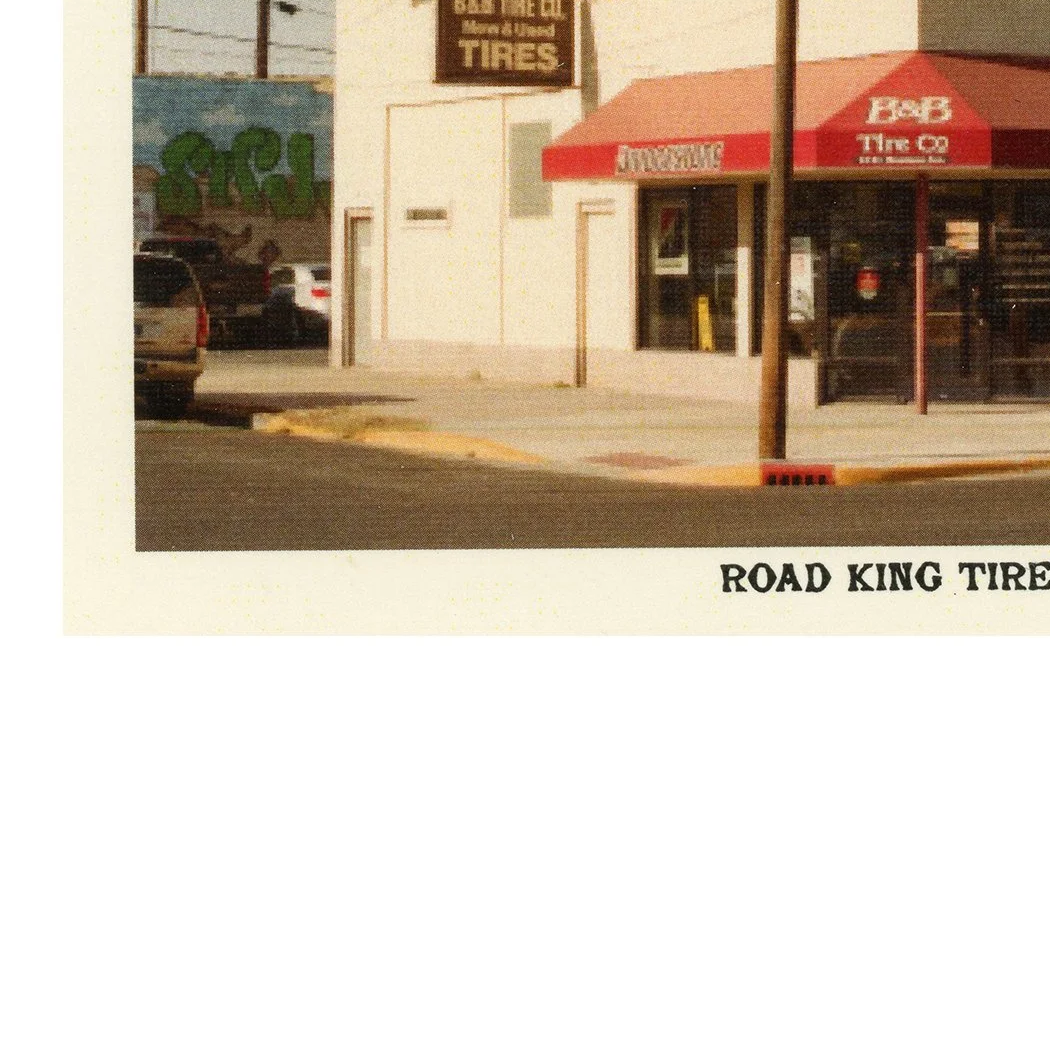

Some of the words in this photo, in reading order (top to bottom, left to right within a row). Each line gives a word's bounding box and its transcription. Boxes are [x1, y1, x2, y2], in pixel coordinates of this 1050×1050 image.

[461, 19, 500, 35] New
[514, 22, 555, 38] Used
[458, 39, 559, 72] TIRES
[865, 96, 953, 124] B&B
[855, 133, 910, 153] Tire
